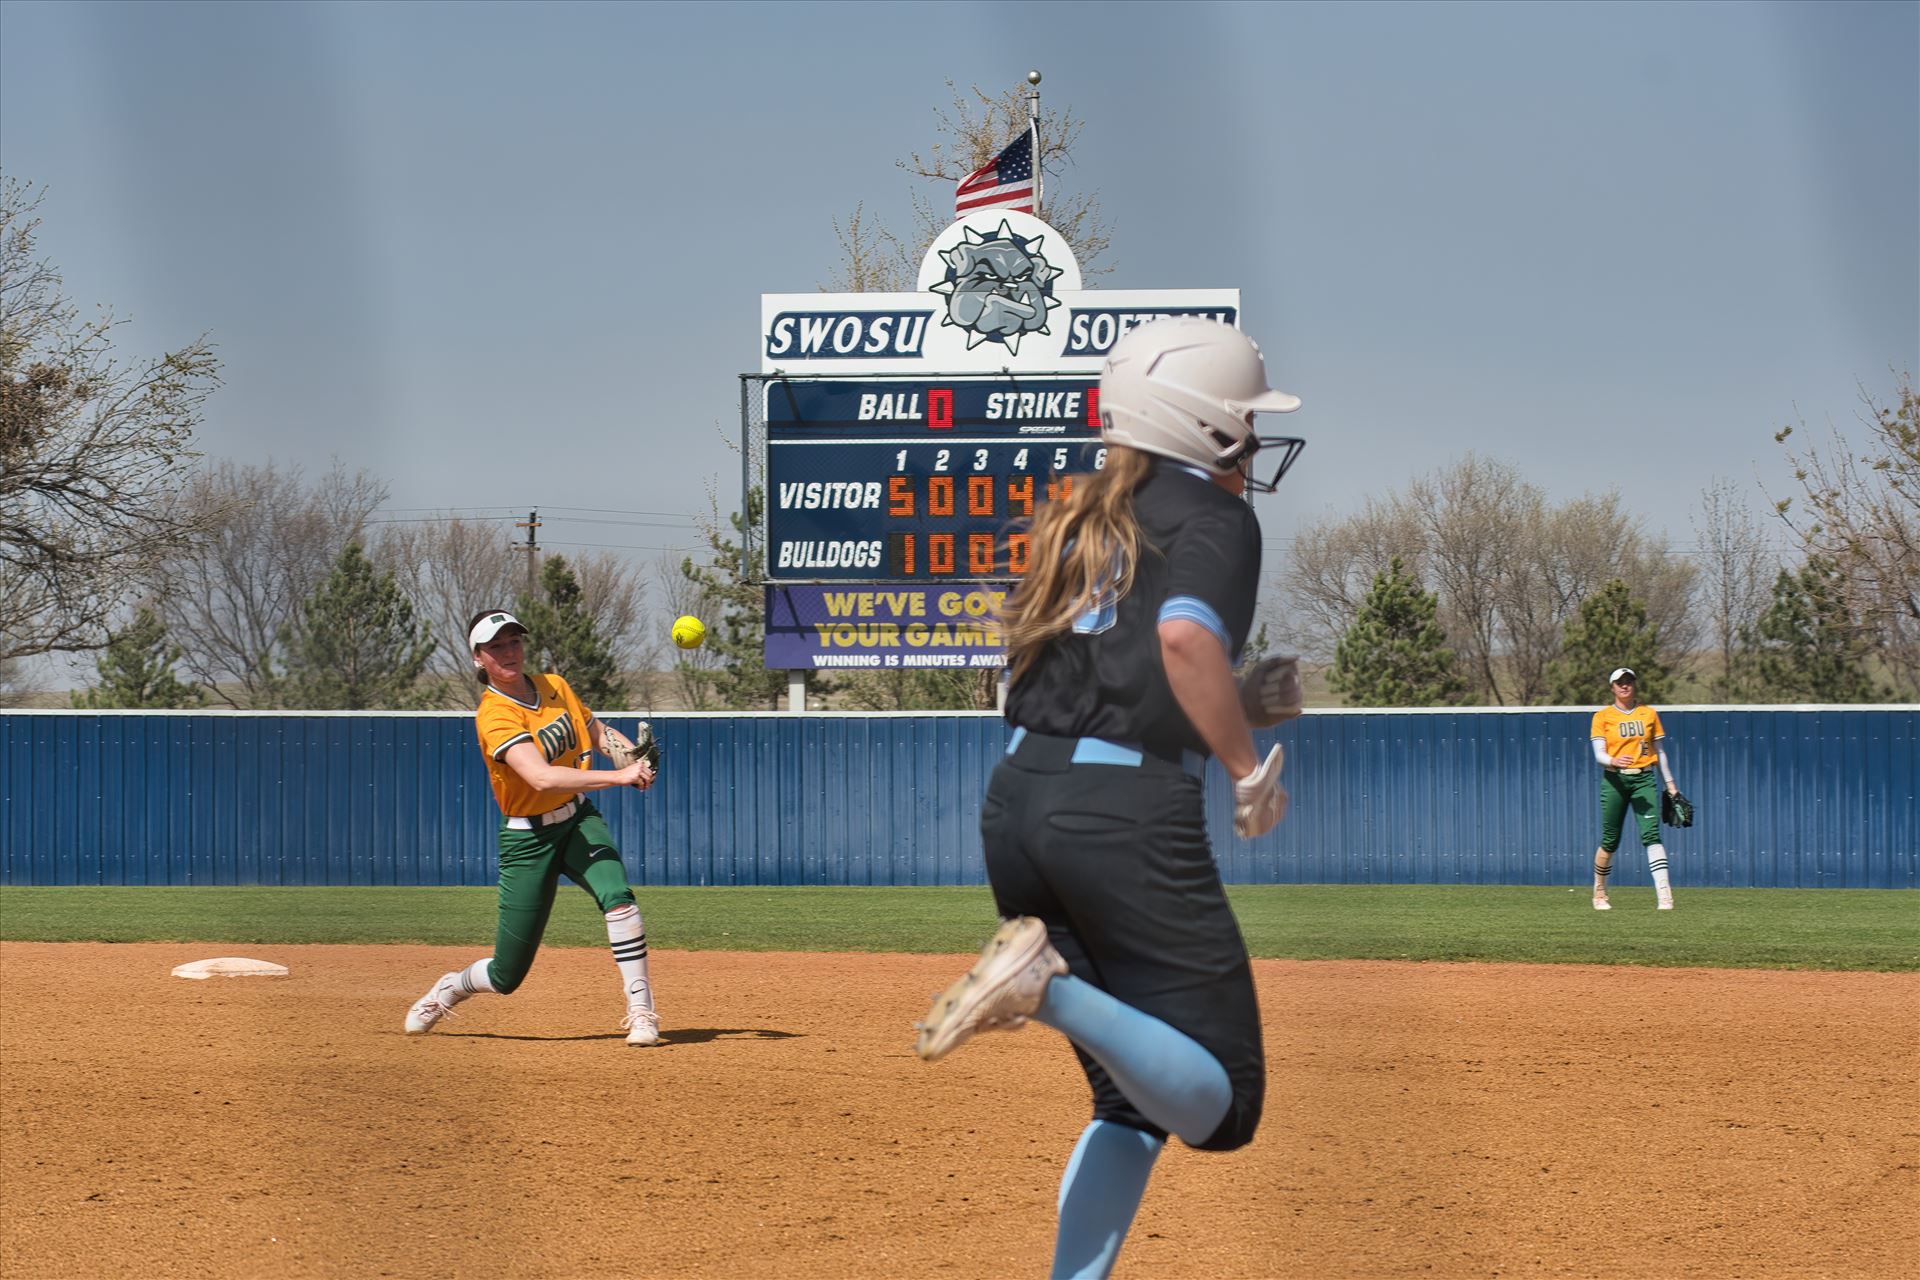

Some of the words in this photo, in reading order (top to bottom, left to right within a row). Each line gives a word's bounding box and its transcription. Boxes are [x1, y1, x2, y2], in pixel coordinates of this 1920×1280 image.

[769, 316, 926, 354] SWOSU
[858, 393, 922, 420] BALL
[928, 389, 953, 428] 0
[985, 392, 1082, 419] STRIKE
[896, 450, 907, 471] 1
[934, 449, 949, 471] 2
[973, 449, 989, 471] 3
[1013, 448, 1029, 470] 4
[1053, 448, 1068, 470] 5
[1094, 448, 1108, 470] 6
[779, 482, 882, 509] VISITOR
[889, 477, 914, 516] 5
[929, 476, 955, 516] 0
[968, 476, 994, 516] 0
[1008, 475, 1033, 516] 4
[778, 540, 882, 568] BULLDOGS
[904, 534, 915, 573] 1
[929, 533, 955, 573] 0
[968, 533, 994, 573] 0
[823, 592, 926, 617] WE'VE
[938, 591, 1007, 617] GOT
[814, 623, 902, 647] YOUR
[812, 655, 881, 667] WINNING
[885, 655, 899, 667] IS
[902, 655, 966, 667] MINUTES
[1619, 720, 1646, 738] OBU
